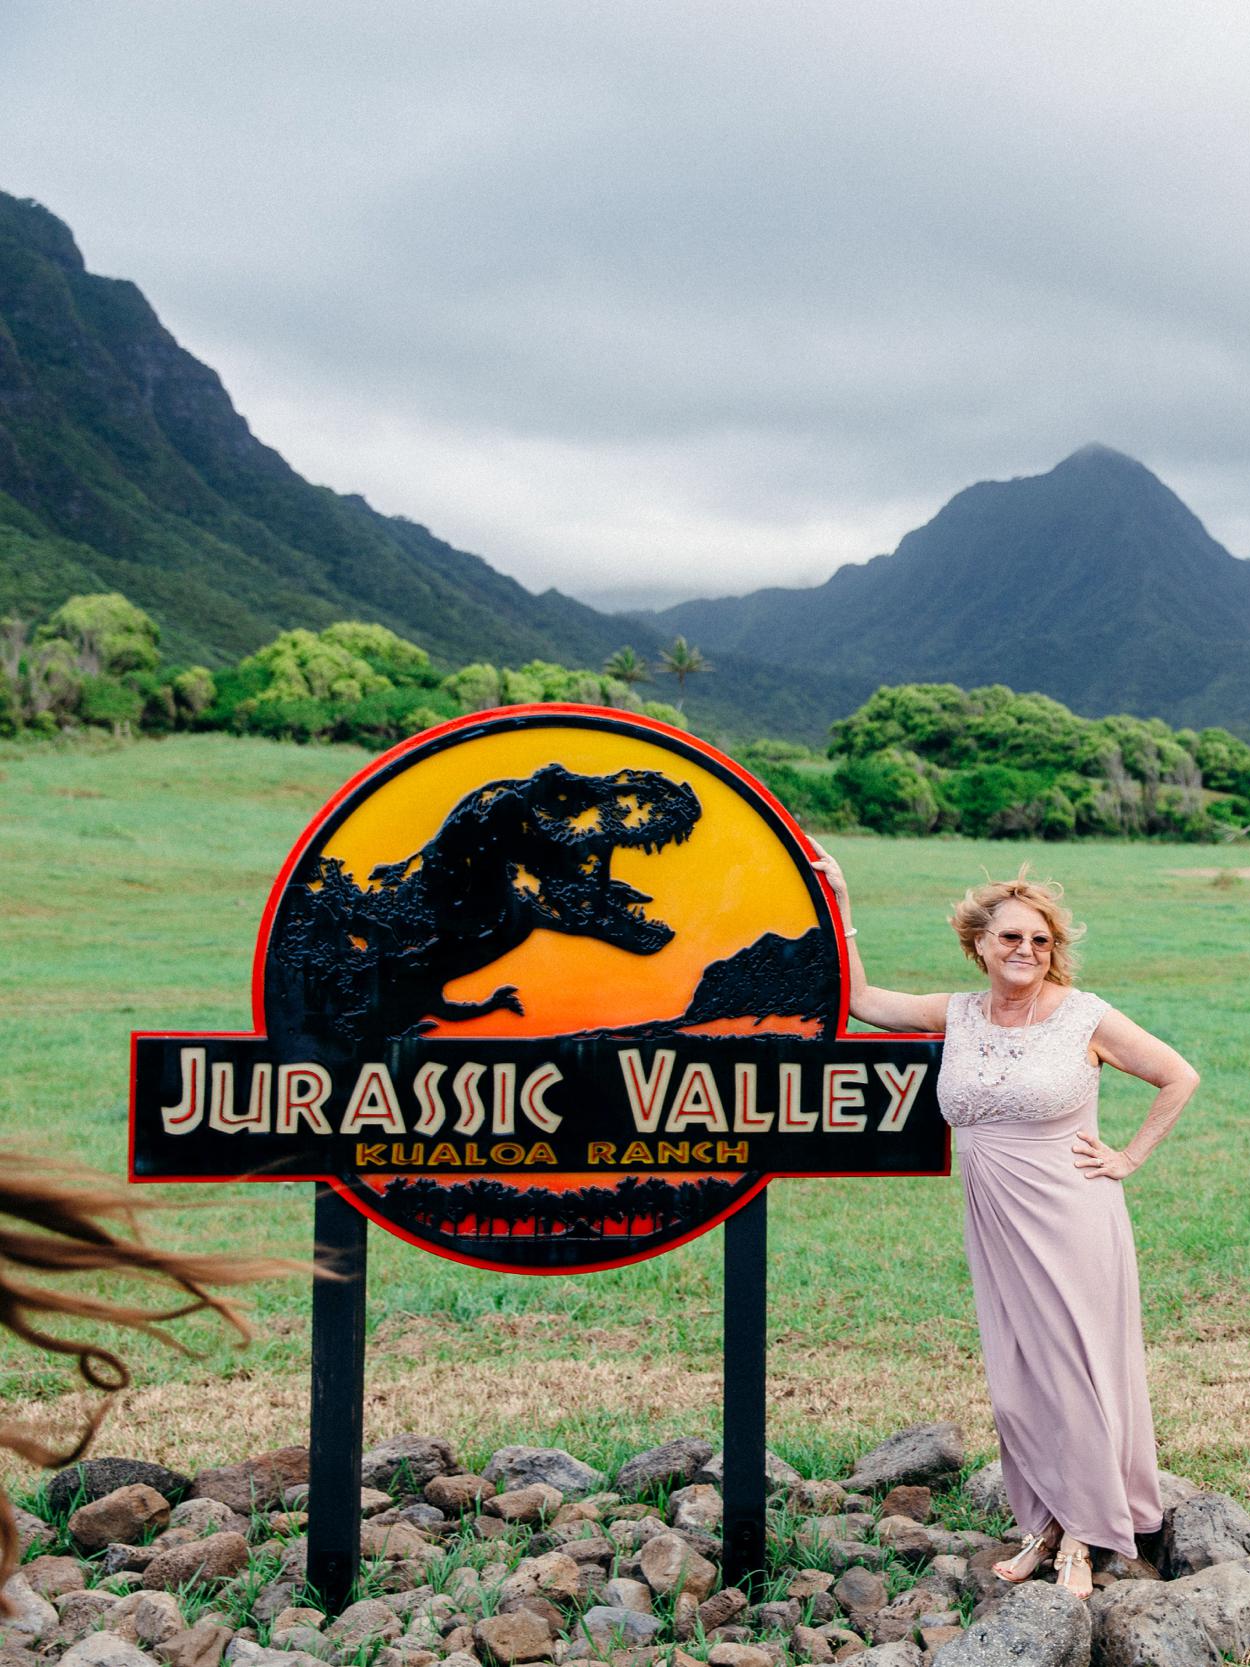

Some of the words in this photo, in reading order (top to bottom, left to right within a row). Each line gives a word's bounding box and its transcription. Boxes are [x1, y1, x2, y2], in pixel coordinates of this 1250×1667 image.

[160, 1047, 565, 1135] JURASSIC
[618, 1048, 928, 1133] VALLEY
[355, 1141, 558, 1166] KUALOA
[587, 1140, 750, 1164] RANCH
